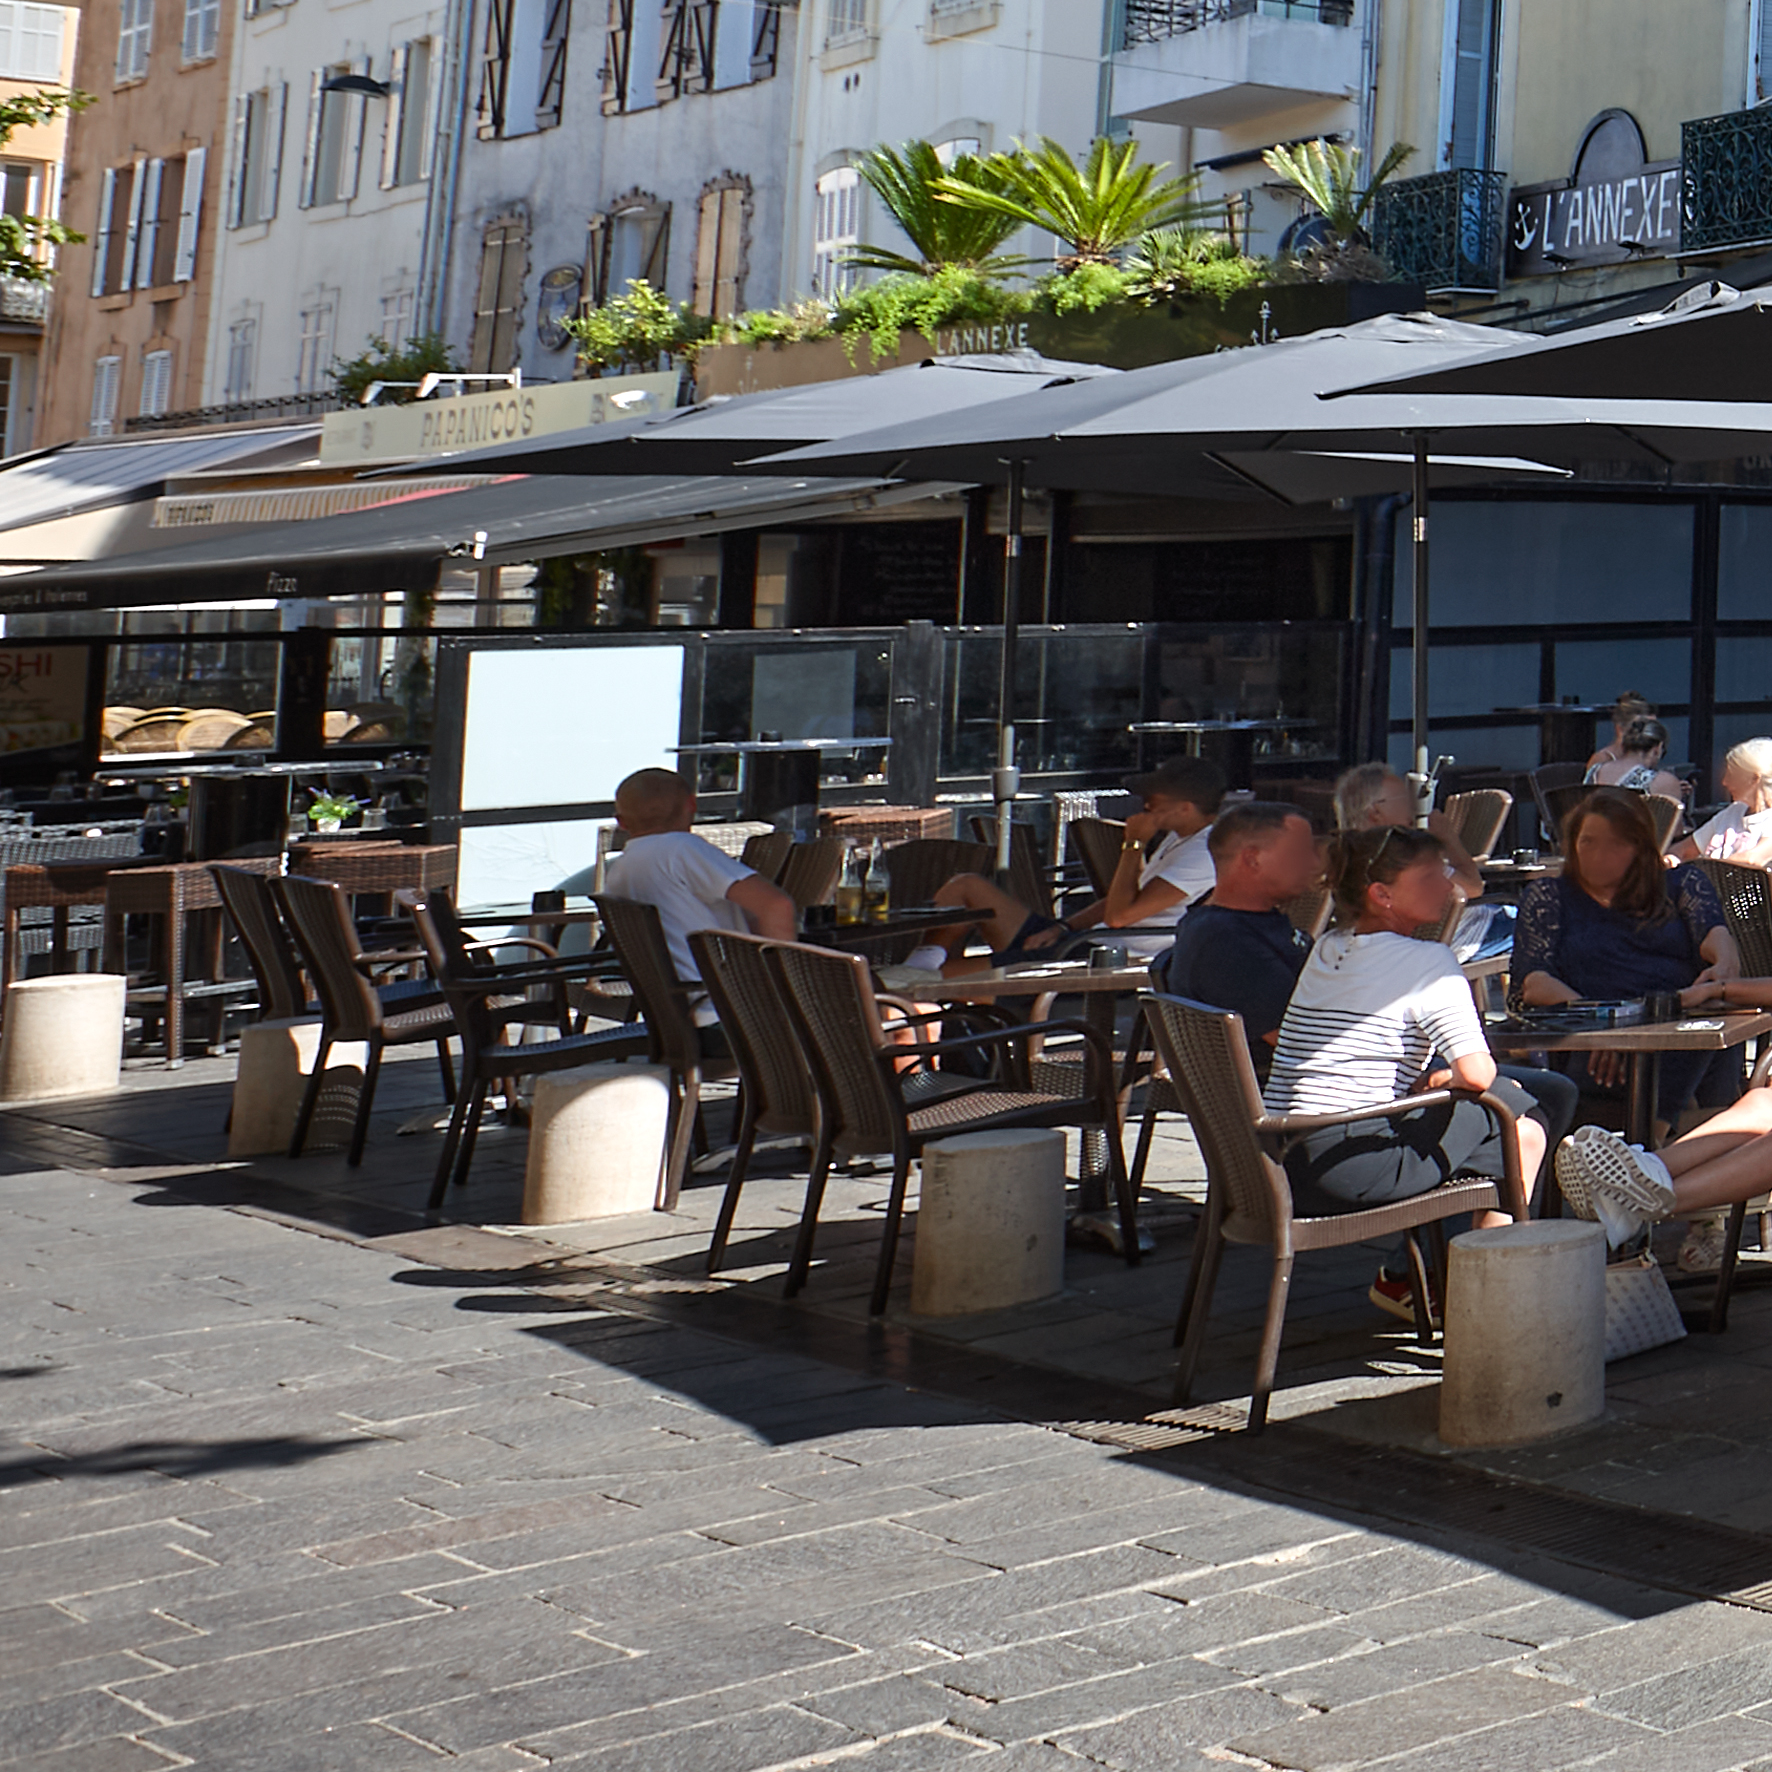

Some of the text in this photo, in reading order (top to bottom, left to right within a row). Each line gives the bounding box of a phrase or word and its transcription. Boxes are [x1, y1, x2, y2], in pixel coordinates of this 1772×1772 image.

[1541, 170, 1679, 251] L'ANNEXE
[935, 322, 1030, 356] L'ANNEXE
[419, 393, 536, 448] PAPANICO'S
